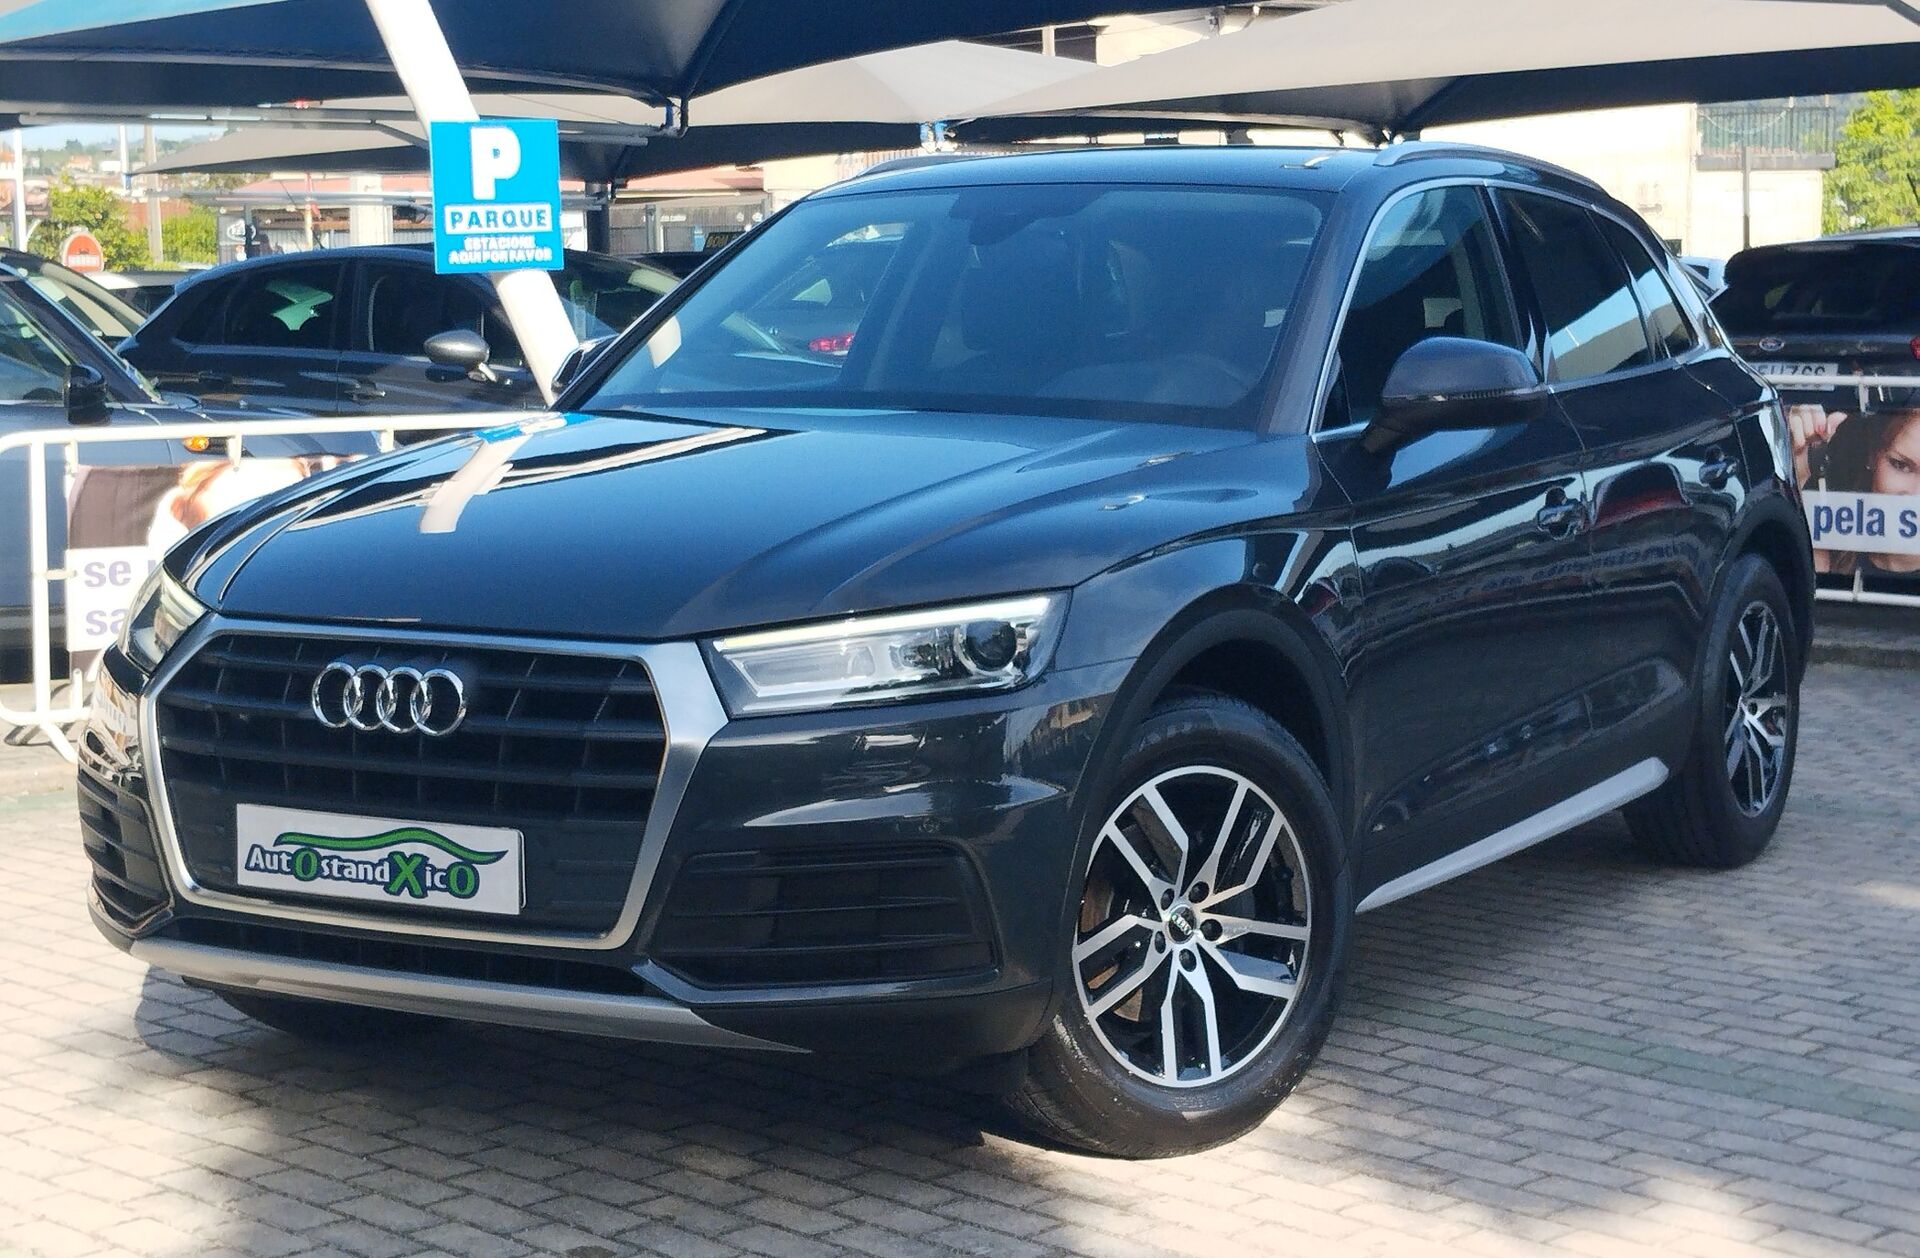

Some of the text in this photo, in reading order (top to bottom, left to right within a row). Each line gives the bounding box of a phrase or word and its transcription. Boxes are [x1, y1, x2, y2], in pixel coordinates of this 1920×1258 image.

[470, 126, 521, 200] P
[450, 209, 547, 229] PARQUE
[1813, 500, 1885, 540] pela
[83, 559, 132, 588] se
